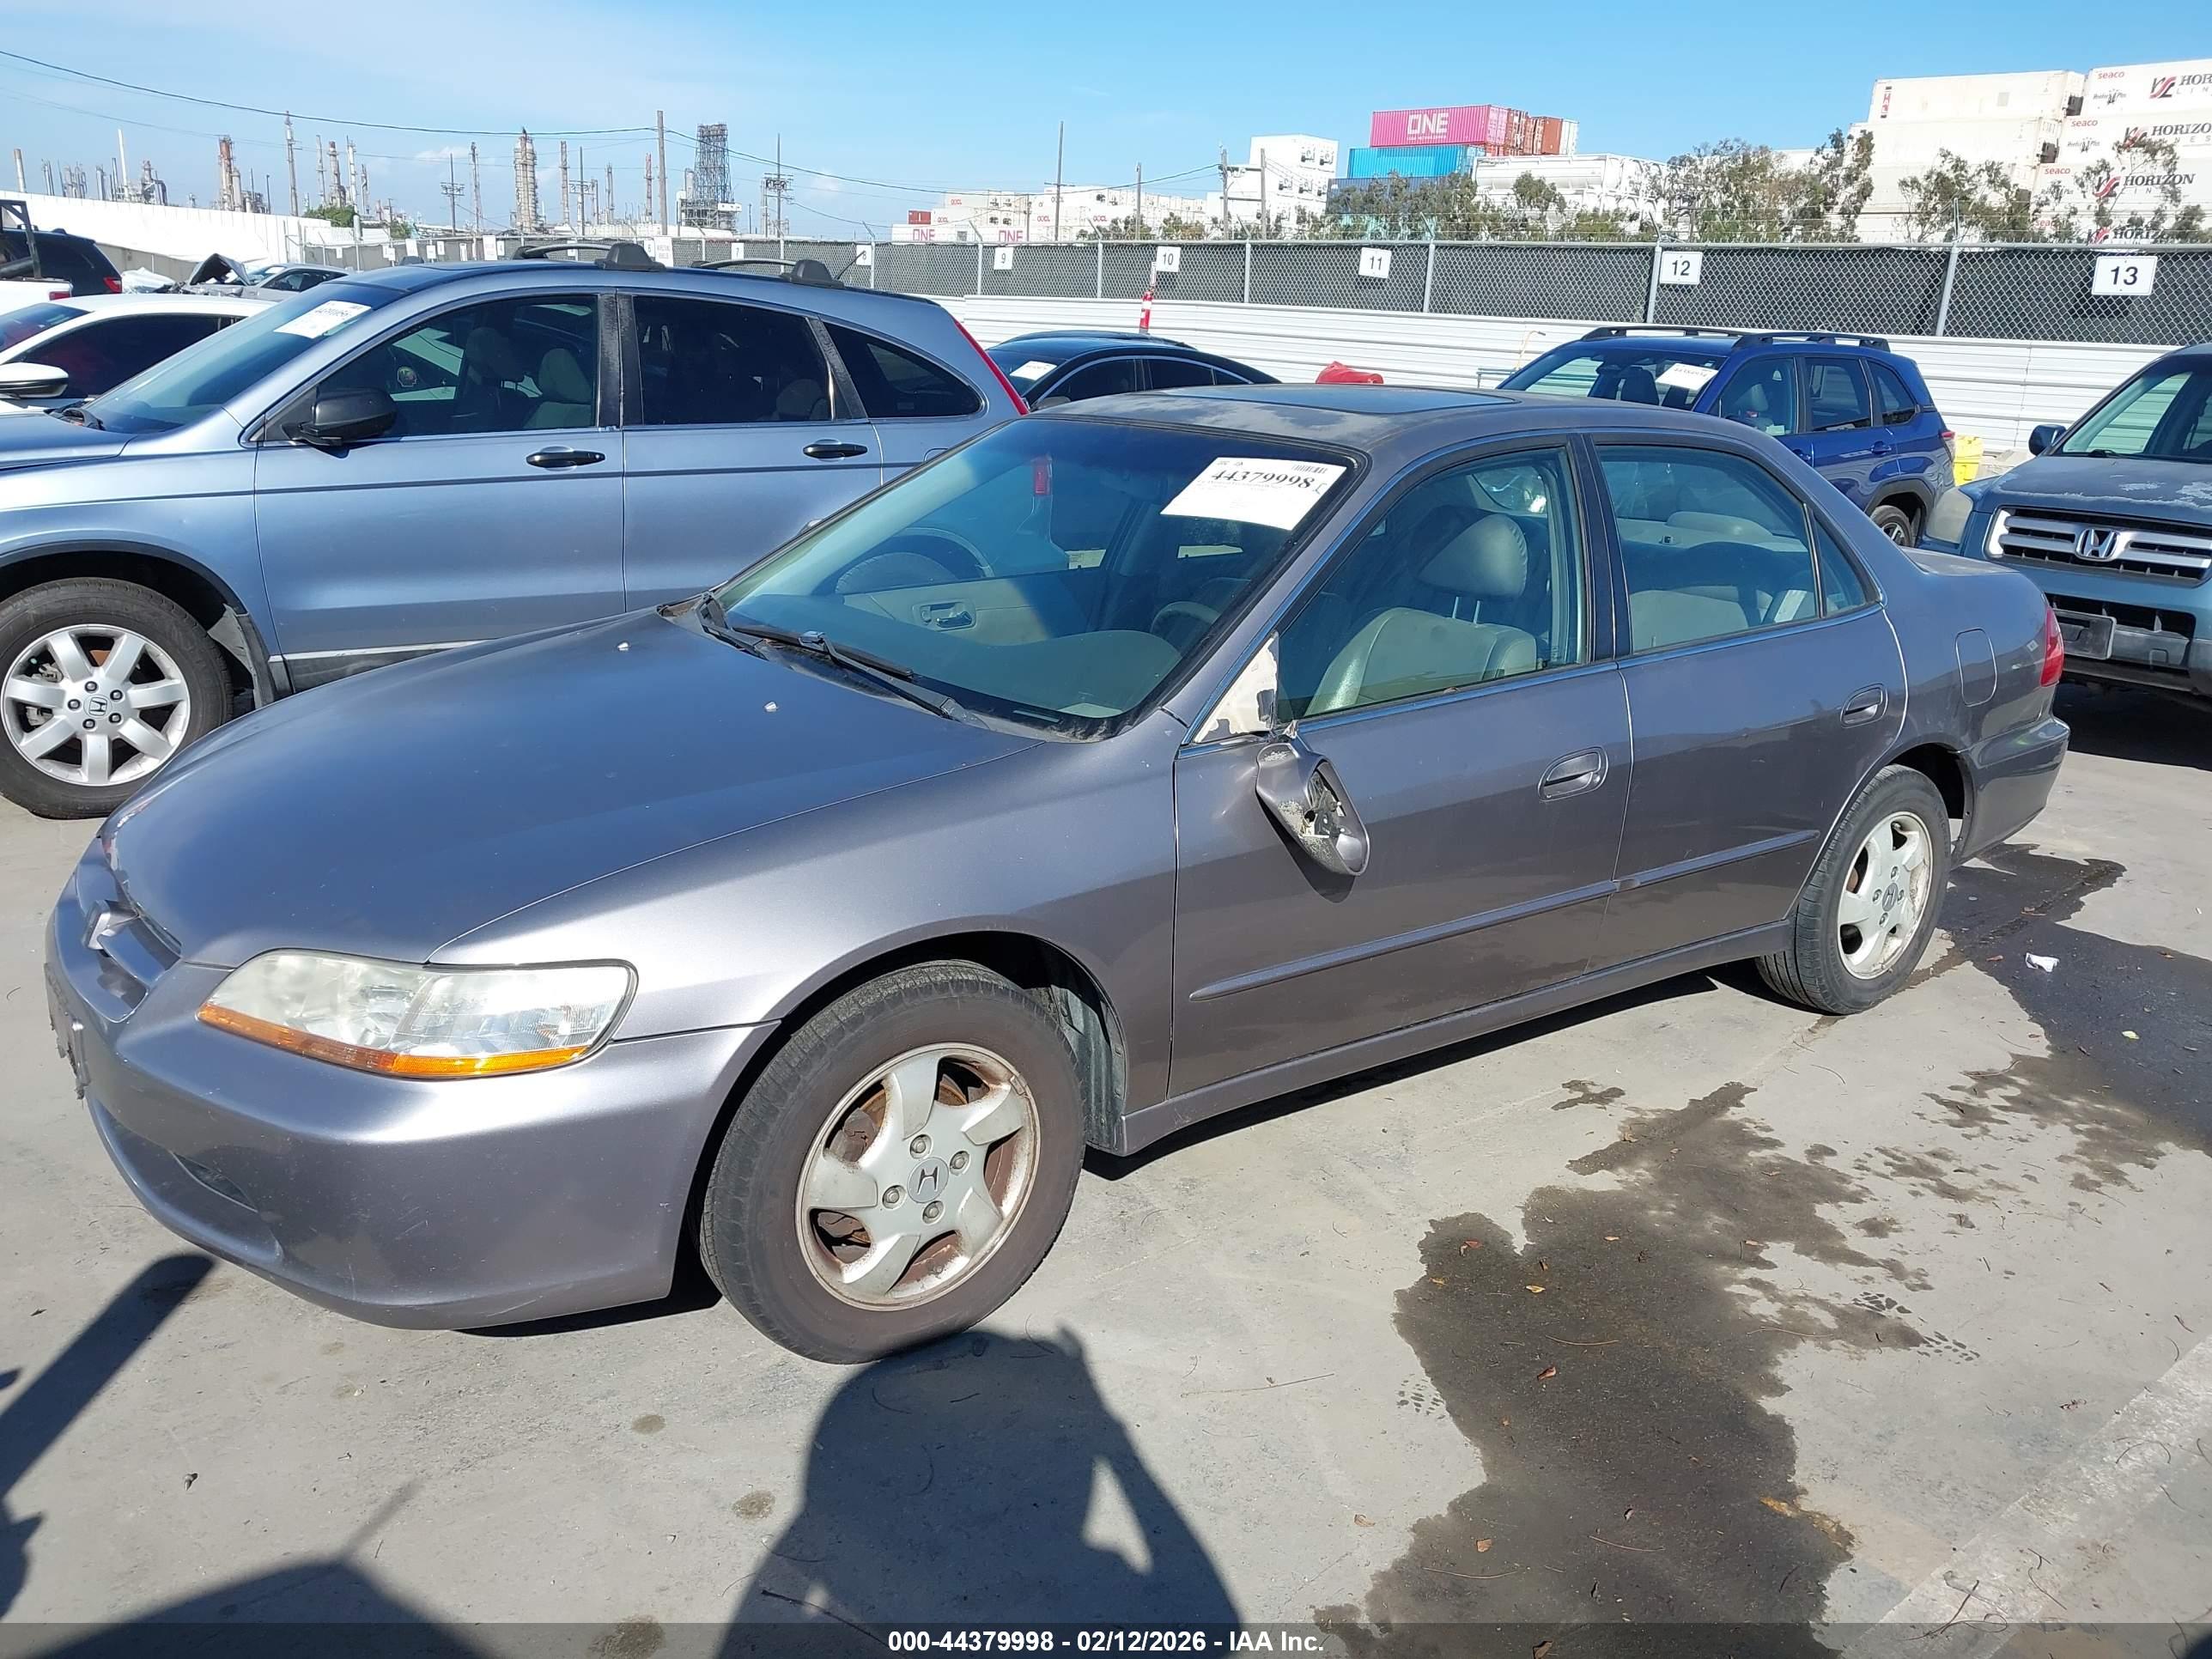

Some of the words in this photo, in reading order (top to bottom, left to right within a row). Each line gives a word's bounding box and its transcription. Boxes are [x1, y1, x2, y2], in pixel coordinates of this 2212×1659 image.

[2098, 71, 2125, 80] seaco
[1407, 112, 1449, 135] ONE
[2123, 173, 2197, 186] HORIZON
[1000, 252, 1006, 264] 9
[1163, 252, 1174, 265] 10
[1370, 256, 1382, 270] 11
[1671, 259, 1691, 276] 12
[2111, 265, 2138, 285] 13
[1211, 469, 1316, 489] 44379998
